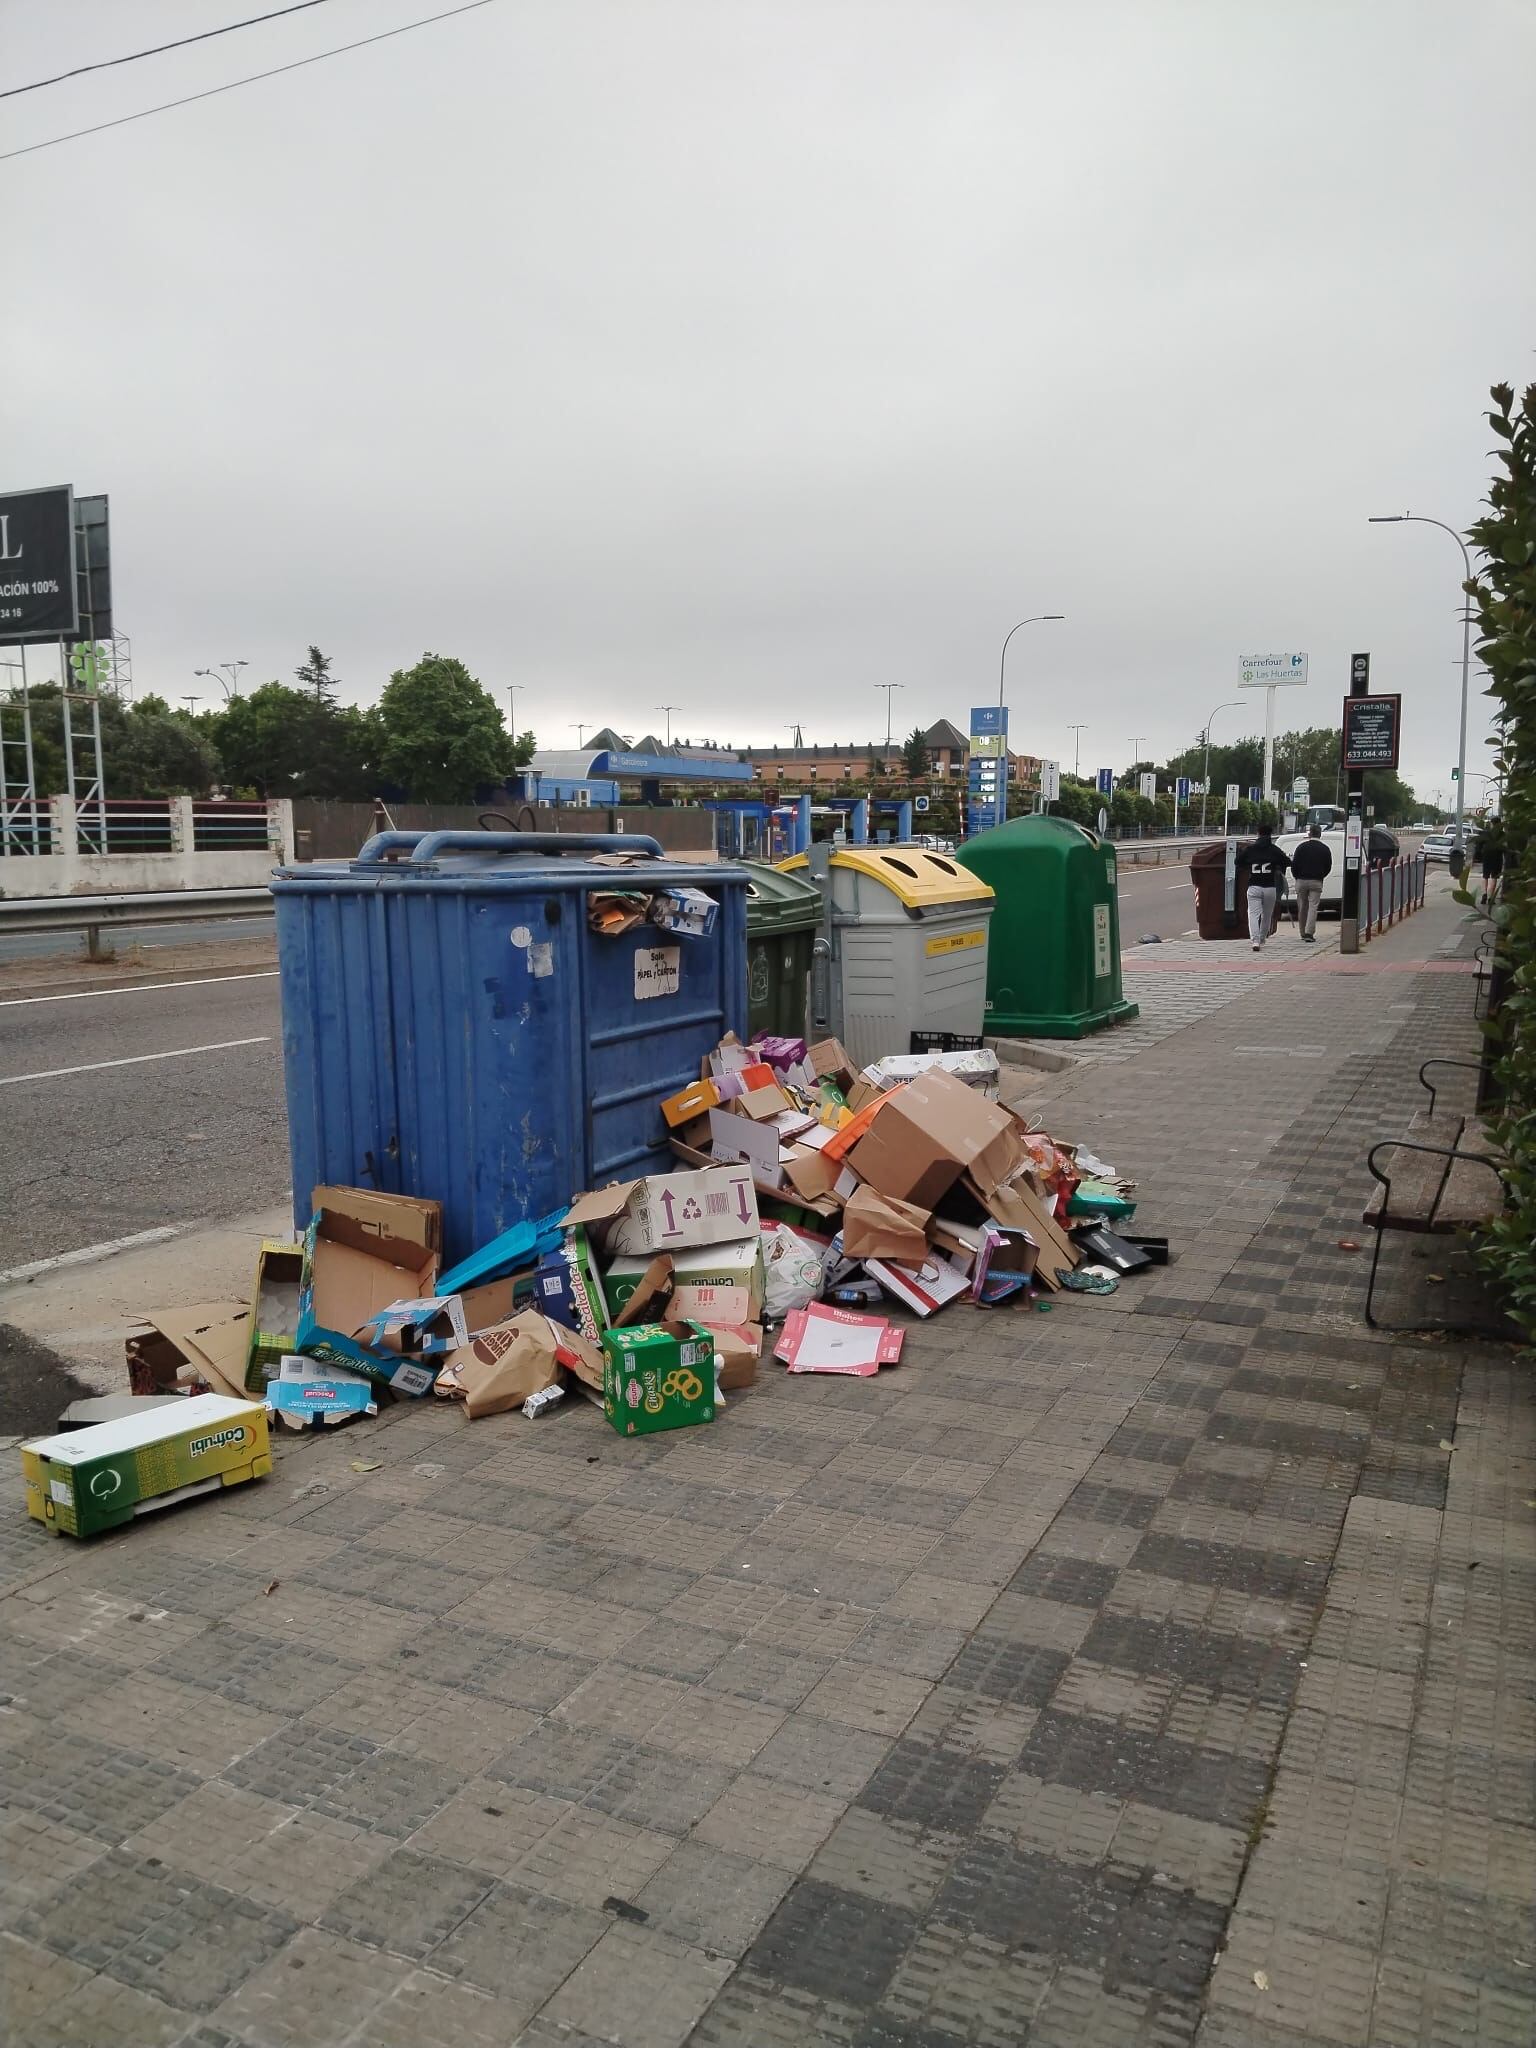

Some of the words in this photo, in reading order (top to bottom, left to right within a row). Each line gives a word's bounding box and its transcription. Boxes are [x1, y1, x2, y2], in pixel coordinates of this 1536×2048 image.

[31, 580, 59, 594] 100%
[1242, 659, 1282, 667] Carrefour
[1256, 671, 1269, 679] Las
[1271, 669, 1303, 678] Huertas
[1347, 750, 1392, 759] 633.044.493
[190, 1426, 245, 1458] Cofrubi
